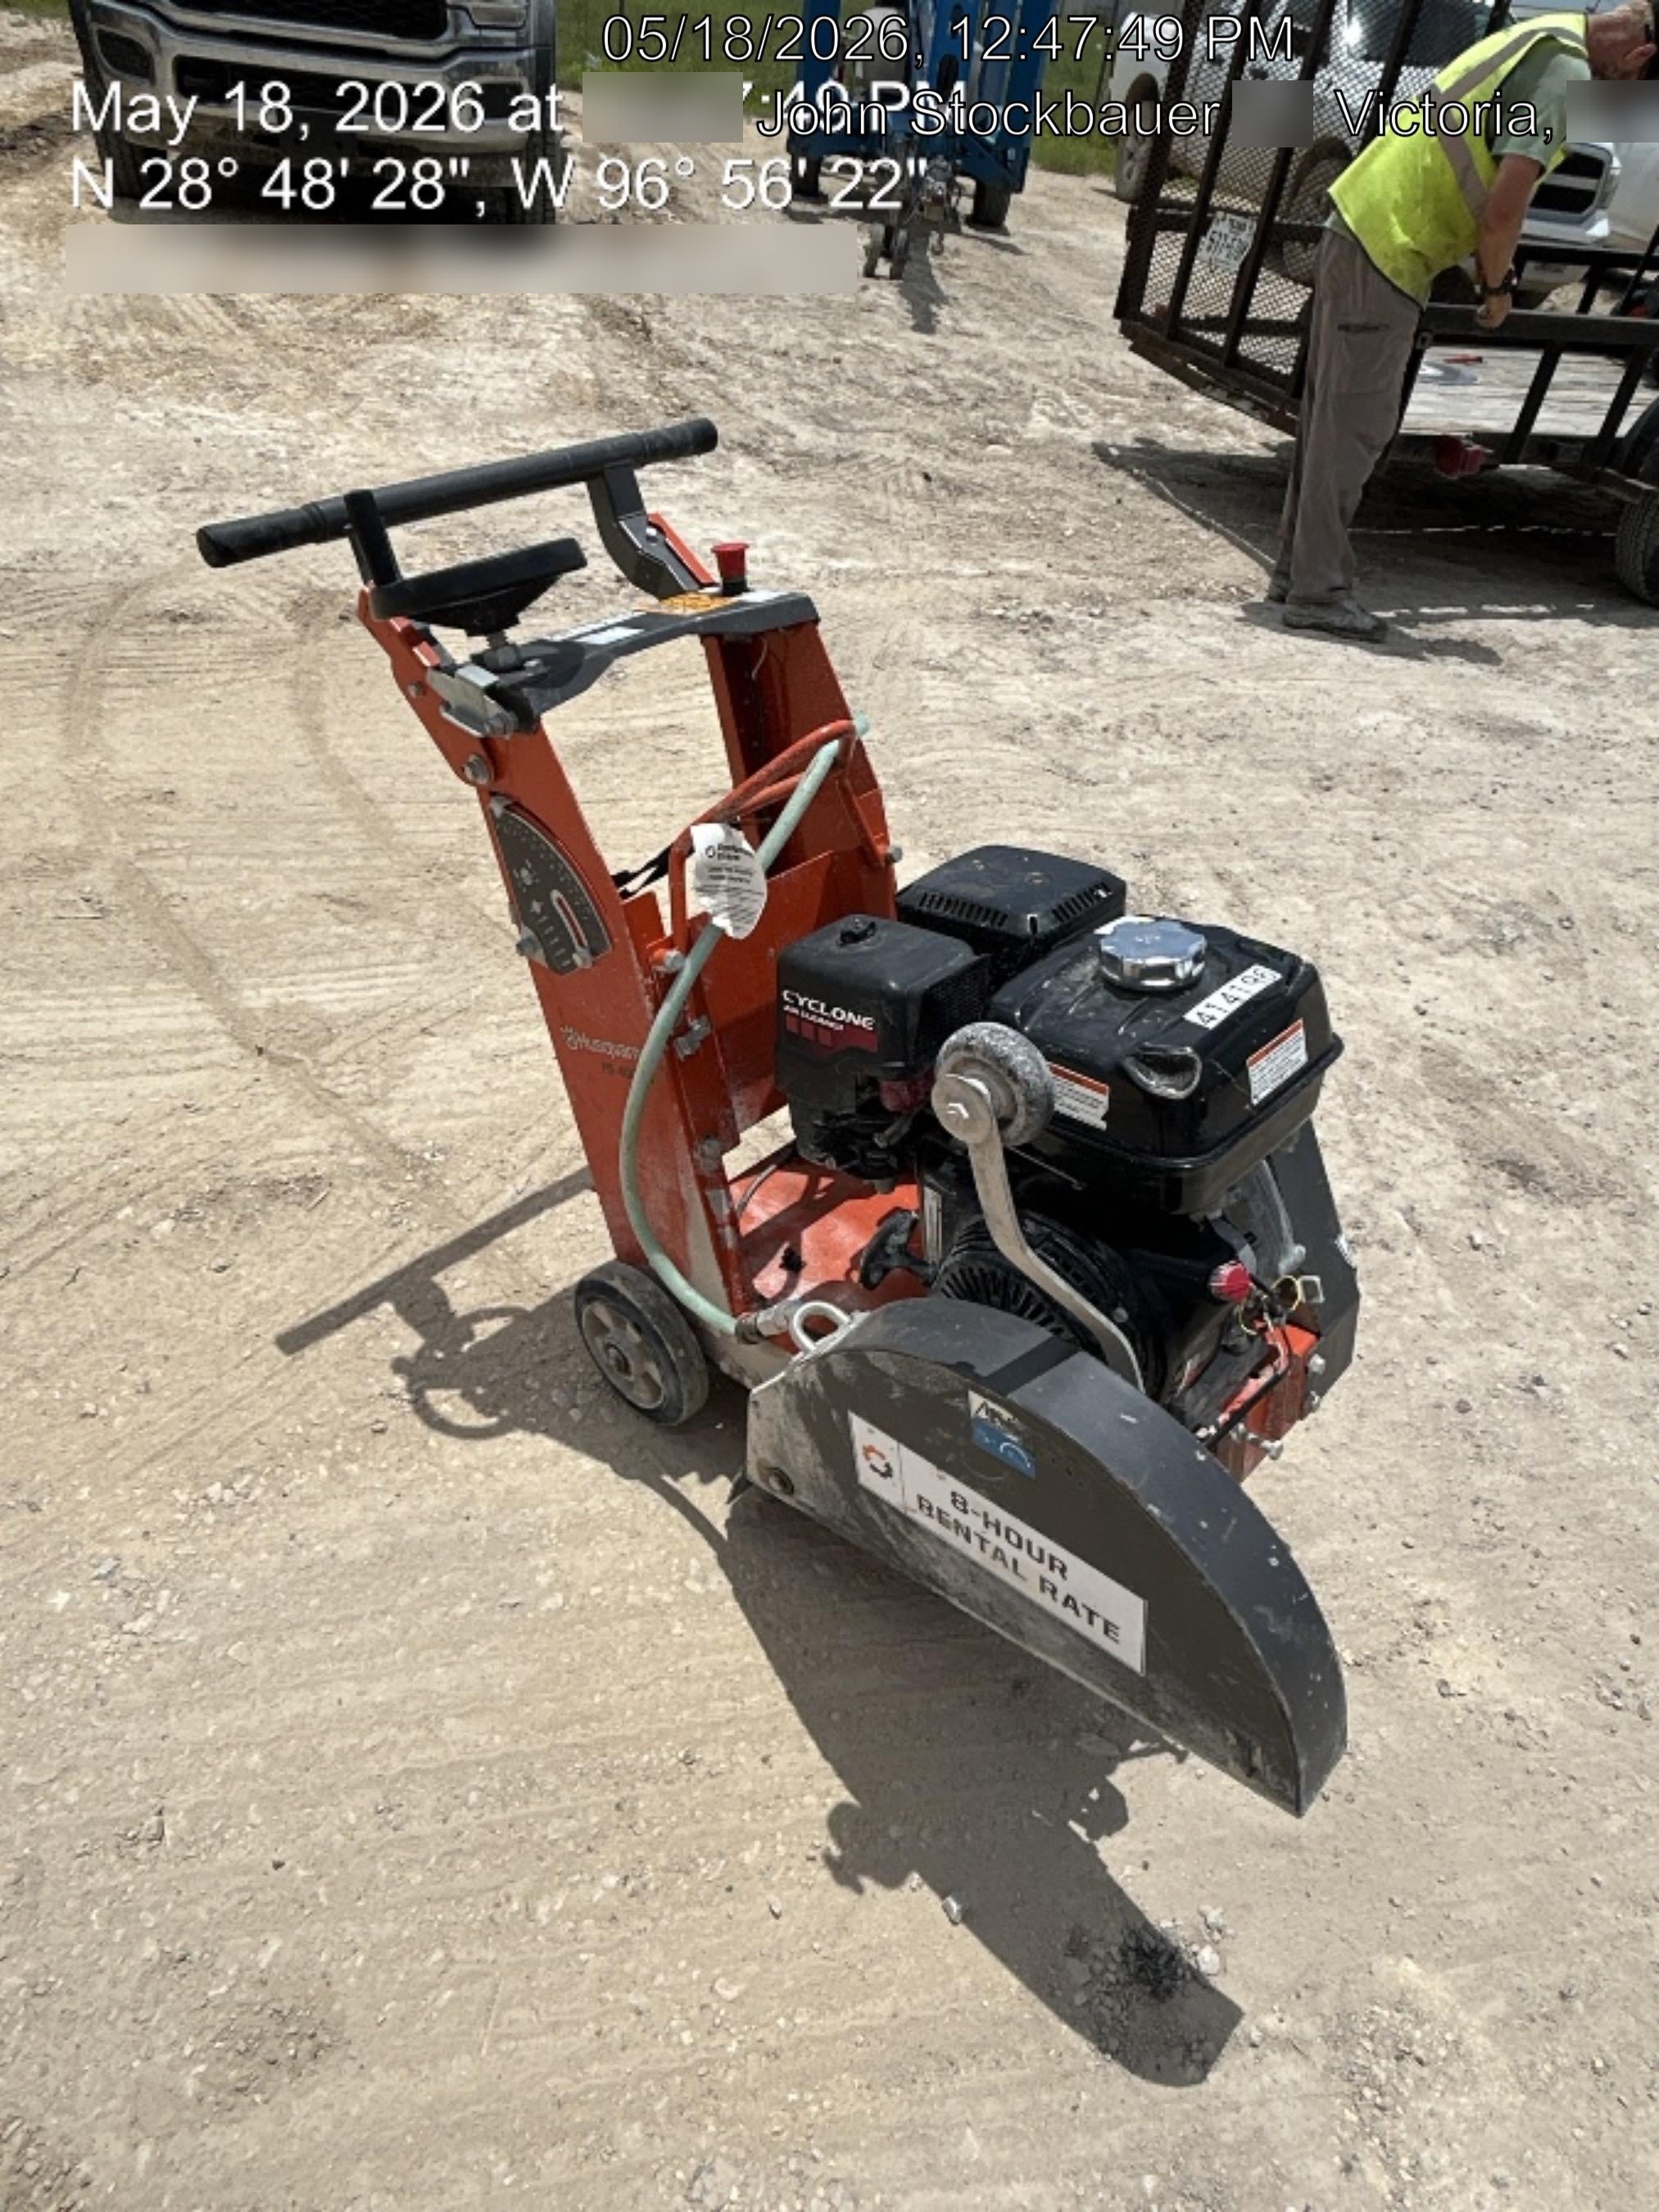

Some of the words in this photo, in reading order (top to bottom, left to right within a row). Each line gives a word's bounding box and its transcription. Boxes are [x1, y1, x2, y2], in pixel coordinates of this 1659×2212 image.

[782, 989, 876, 1031] CYCLONE
[916, 1494, 1028, 1582] RENTAL
[1039, 1575, 1122, 1645] RATE
[950, 1490, 1068, 1581] 8-HOUR
